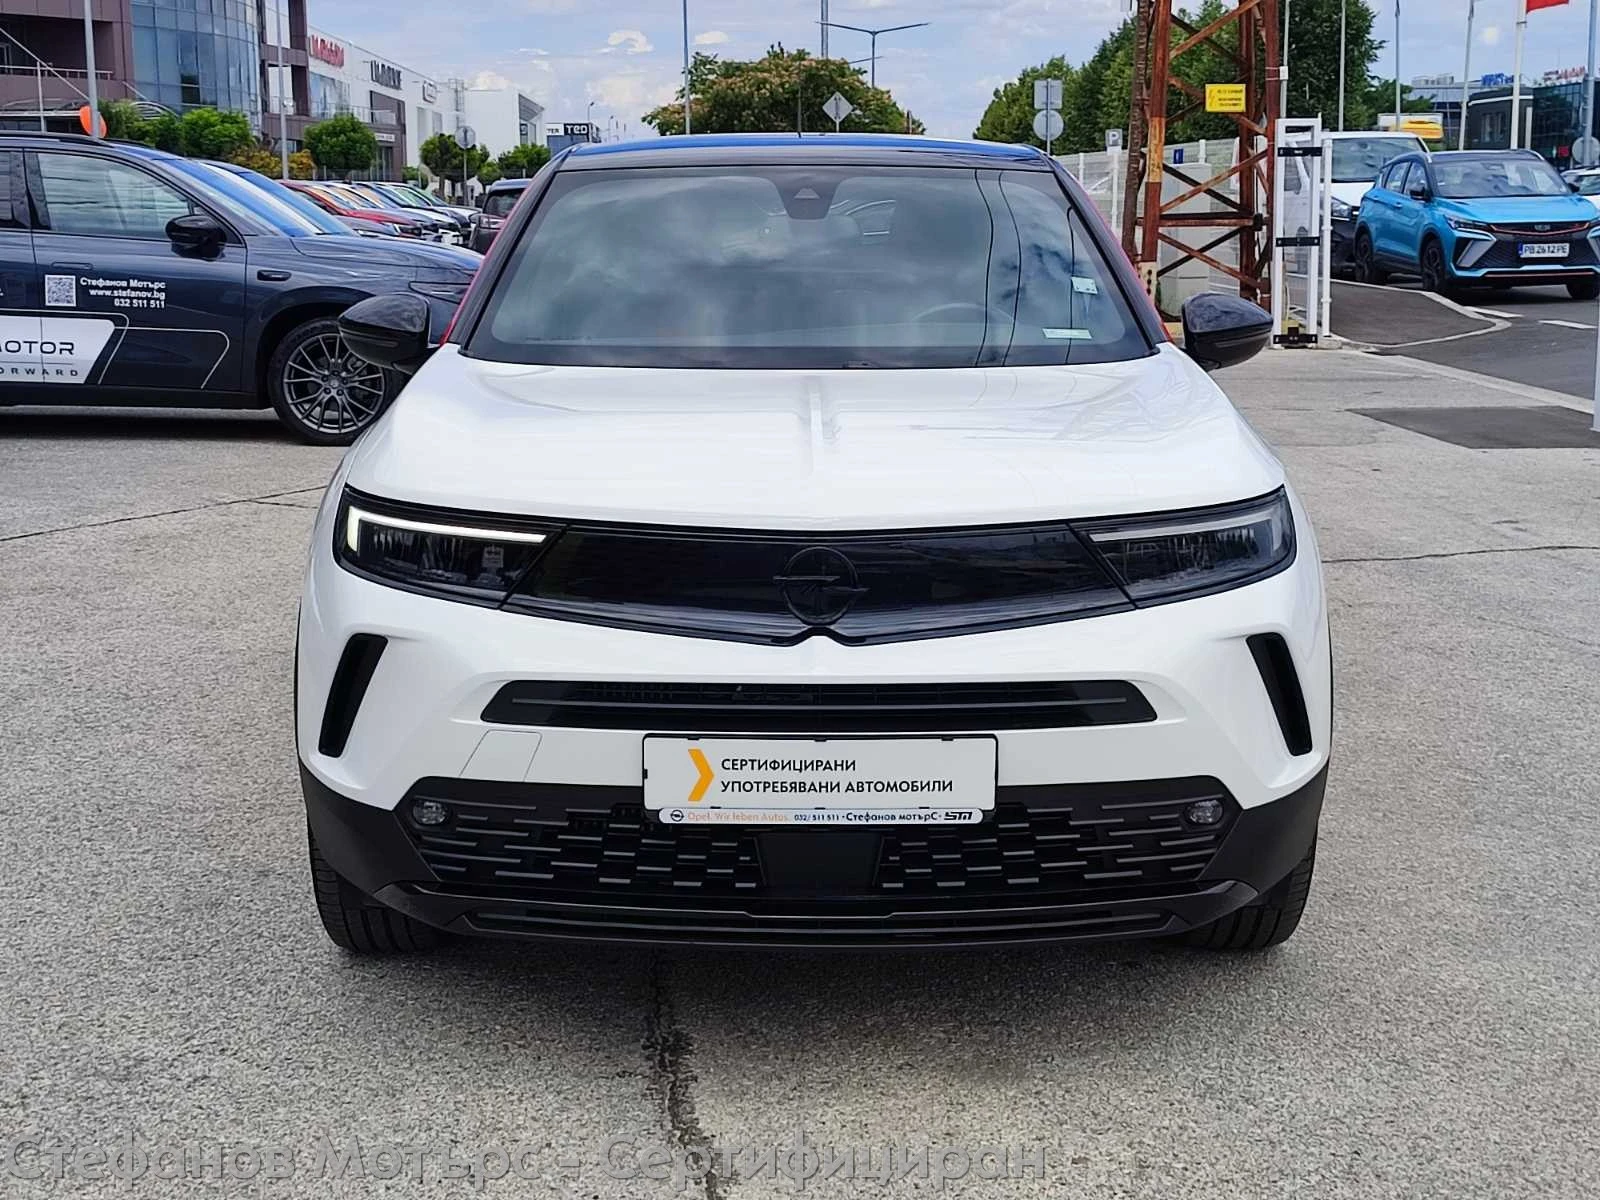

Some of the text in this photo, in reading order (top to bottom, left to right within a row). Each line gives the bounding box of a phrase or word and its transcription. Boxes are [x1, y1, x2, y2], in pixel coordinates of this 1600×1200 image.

[80, 277, 166, 289] Стефанов Мотърс
[89, 289, 166, 299] www.stefanov.bg
[114, 298, 165, 308] 032 511 511
[721, 758, 856, 773] СЕРТИФИЦИРАНИ
[721, 780, 953, 793] УПОТРЕБЯВАНИ АВТОМОБИЛИ
[732, 811, 760, 821] leben
